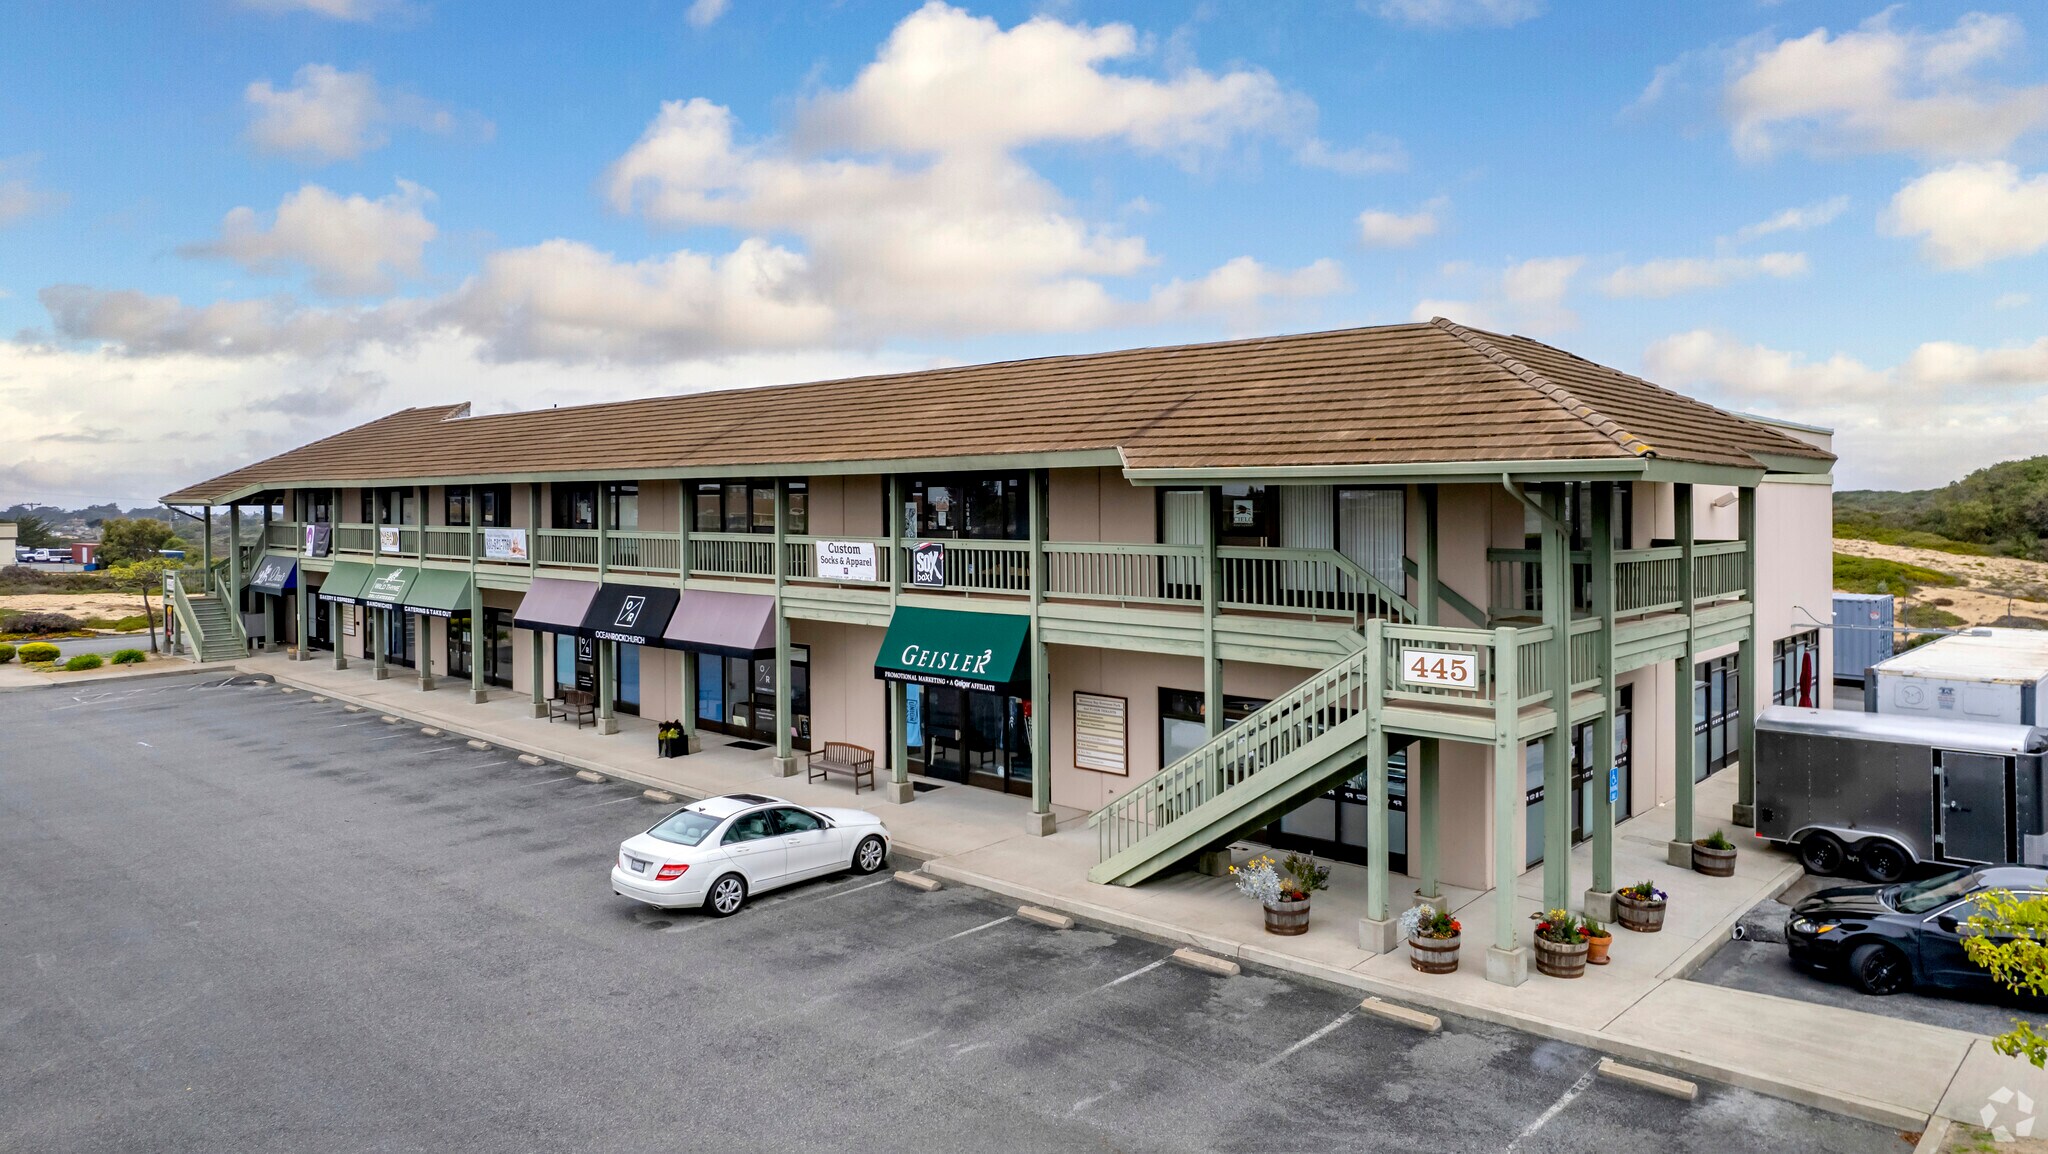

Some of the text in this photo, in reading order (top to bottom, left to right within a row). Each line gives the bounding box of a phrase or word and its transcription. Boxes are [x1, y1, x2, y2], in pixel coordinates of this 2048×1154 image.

[828, 543, 861, 555] Custom
[820, 556, 872, 568] Socks & Apparel
[319, 594, 334, 602] BAKERY
[366, 601, 393, 610] SANDWICHES
[404, 606, 425, 614] CATERING
[595, 631, 646, 644] OCEANROCKCHURCH
[1411, 656, 1468, 682] 445
[884, 671, 917, 681] PROMOTIONAL
[918, 675, 946, 685] MARKETING
[971, 683, 996, 692] AFFILIATE
